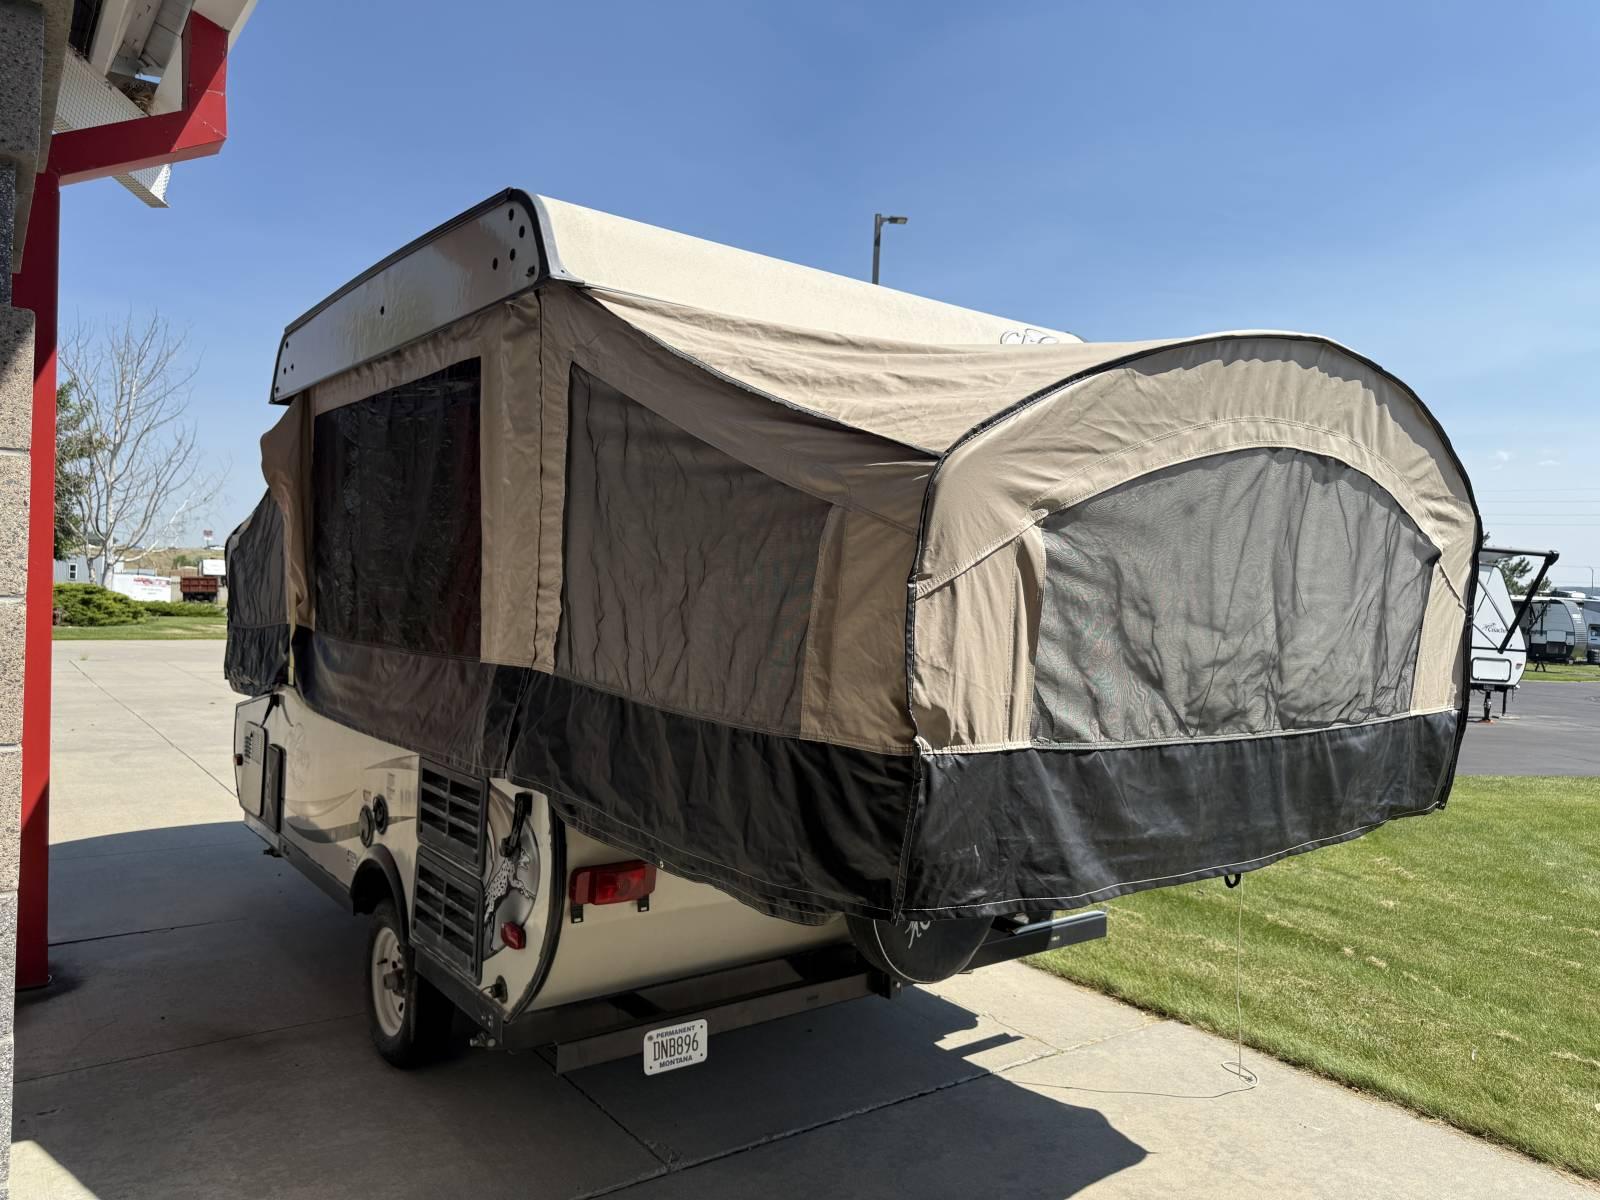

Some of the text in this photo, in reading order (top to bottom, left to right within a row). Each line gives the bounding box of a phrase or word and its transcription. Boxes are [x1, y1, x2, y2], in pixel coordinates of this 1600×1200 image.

[656, 1025, 696, 1039] PERMANENT
[653, 1032, 699, 1061] DNB896
[659, 1055, 693, 1068] MONTANA
